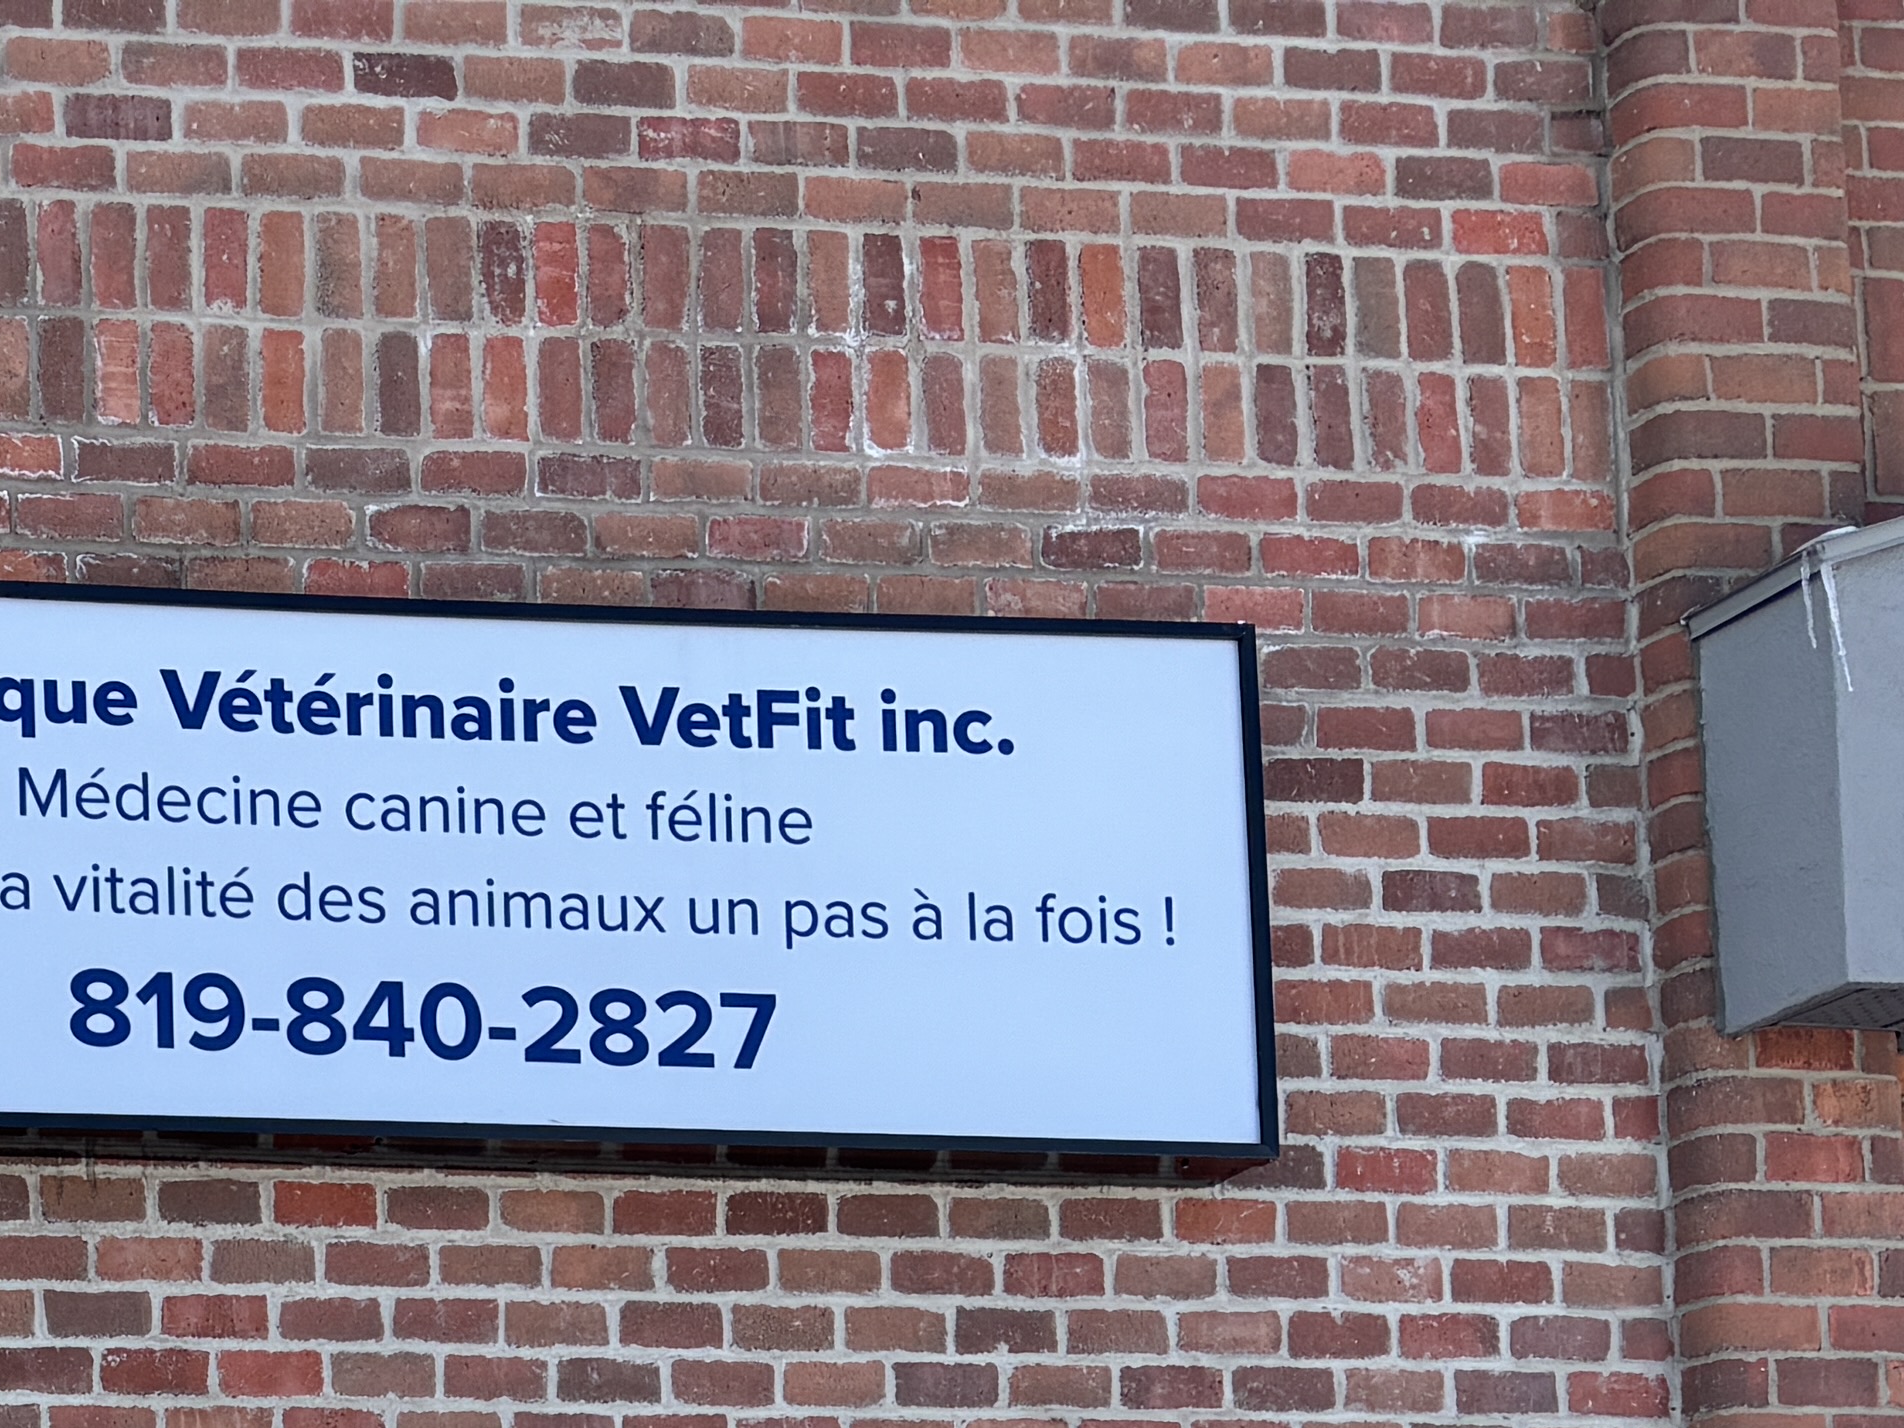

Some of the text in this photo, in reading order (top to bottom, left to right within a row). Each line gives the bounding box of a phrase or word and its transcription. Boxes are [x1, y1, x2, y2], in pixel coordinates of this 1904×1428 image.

[159, 668, 597, 744] Vétérinaire
[619, 686, 856, 751] VetFit
[881, 688, 1014, 755] inc.
[18, 767, 812, 845] Médecine canine et féline
[53, 862, 253, 919] vitalité
[278, 871, 386, 924] des
[410, 878, 666, 933] animaux
[689, 898, 758, 935] un
[785, 900, 888, 949] pas
[913, 888, 942, 940] à
[968, 892, 1013, 942] la
[1036, 893, 1141, 945] fois
[1165, 897, 1174, 946] !
[70, 968, 776, 1069] 819-840-2827
